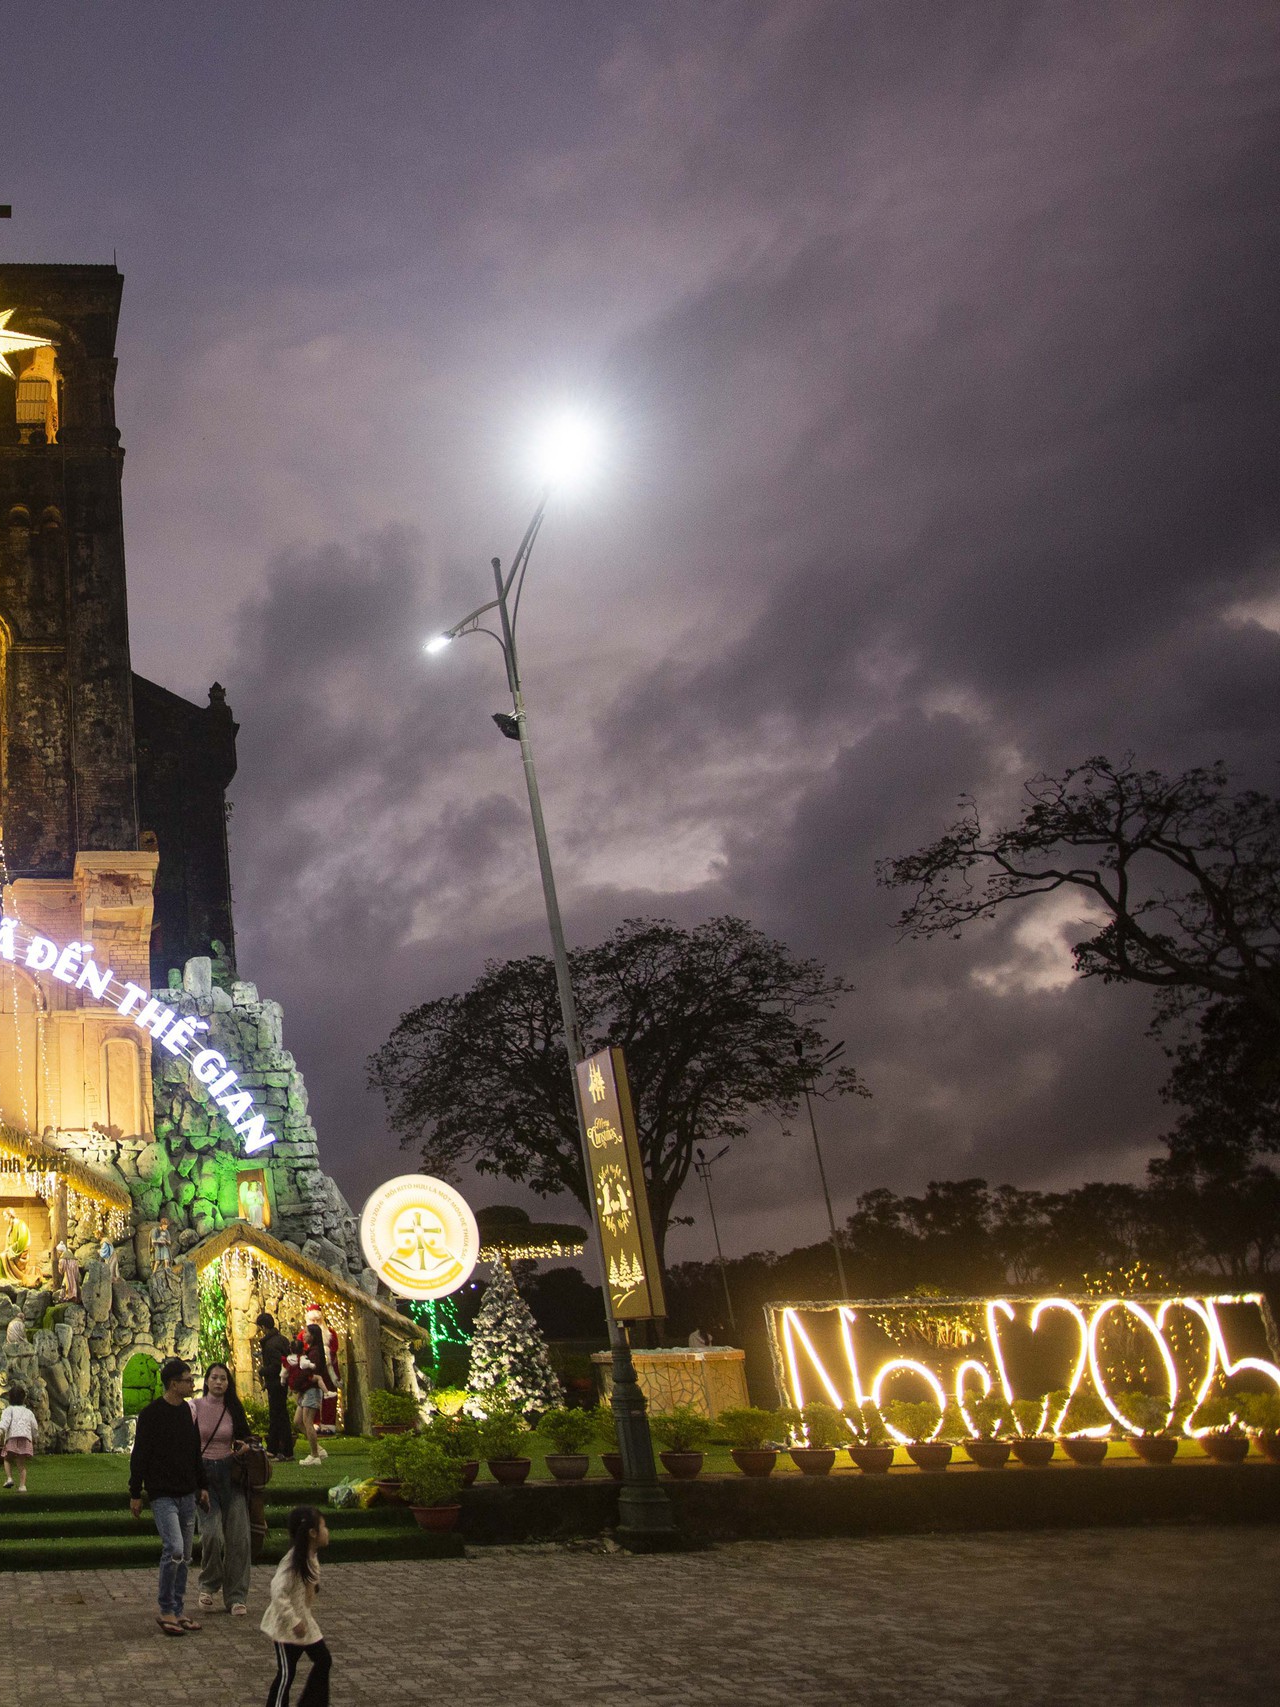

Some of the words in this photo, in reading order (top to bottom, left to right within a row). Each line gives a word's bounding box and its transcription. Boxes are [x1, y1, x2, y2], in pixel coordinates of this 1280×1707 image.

[24, 934, 114, 1000] ĐẾN
[117, 981, 210, 1056] THẾ
[192, 1049, 277, 1154] GIAN
[782, 1298, 1040, 1446] Noel
[1031, 1296, 1280, 1439] 2025
